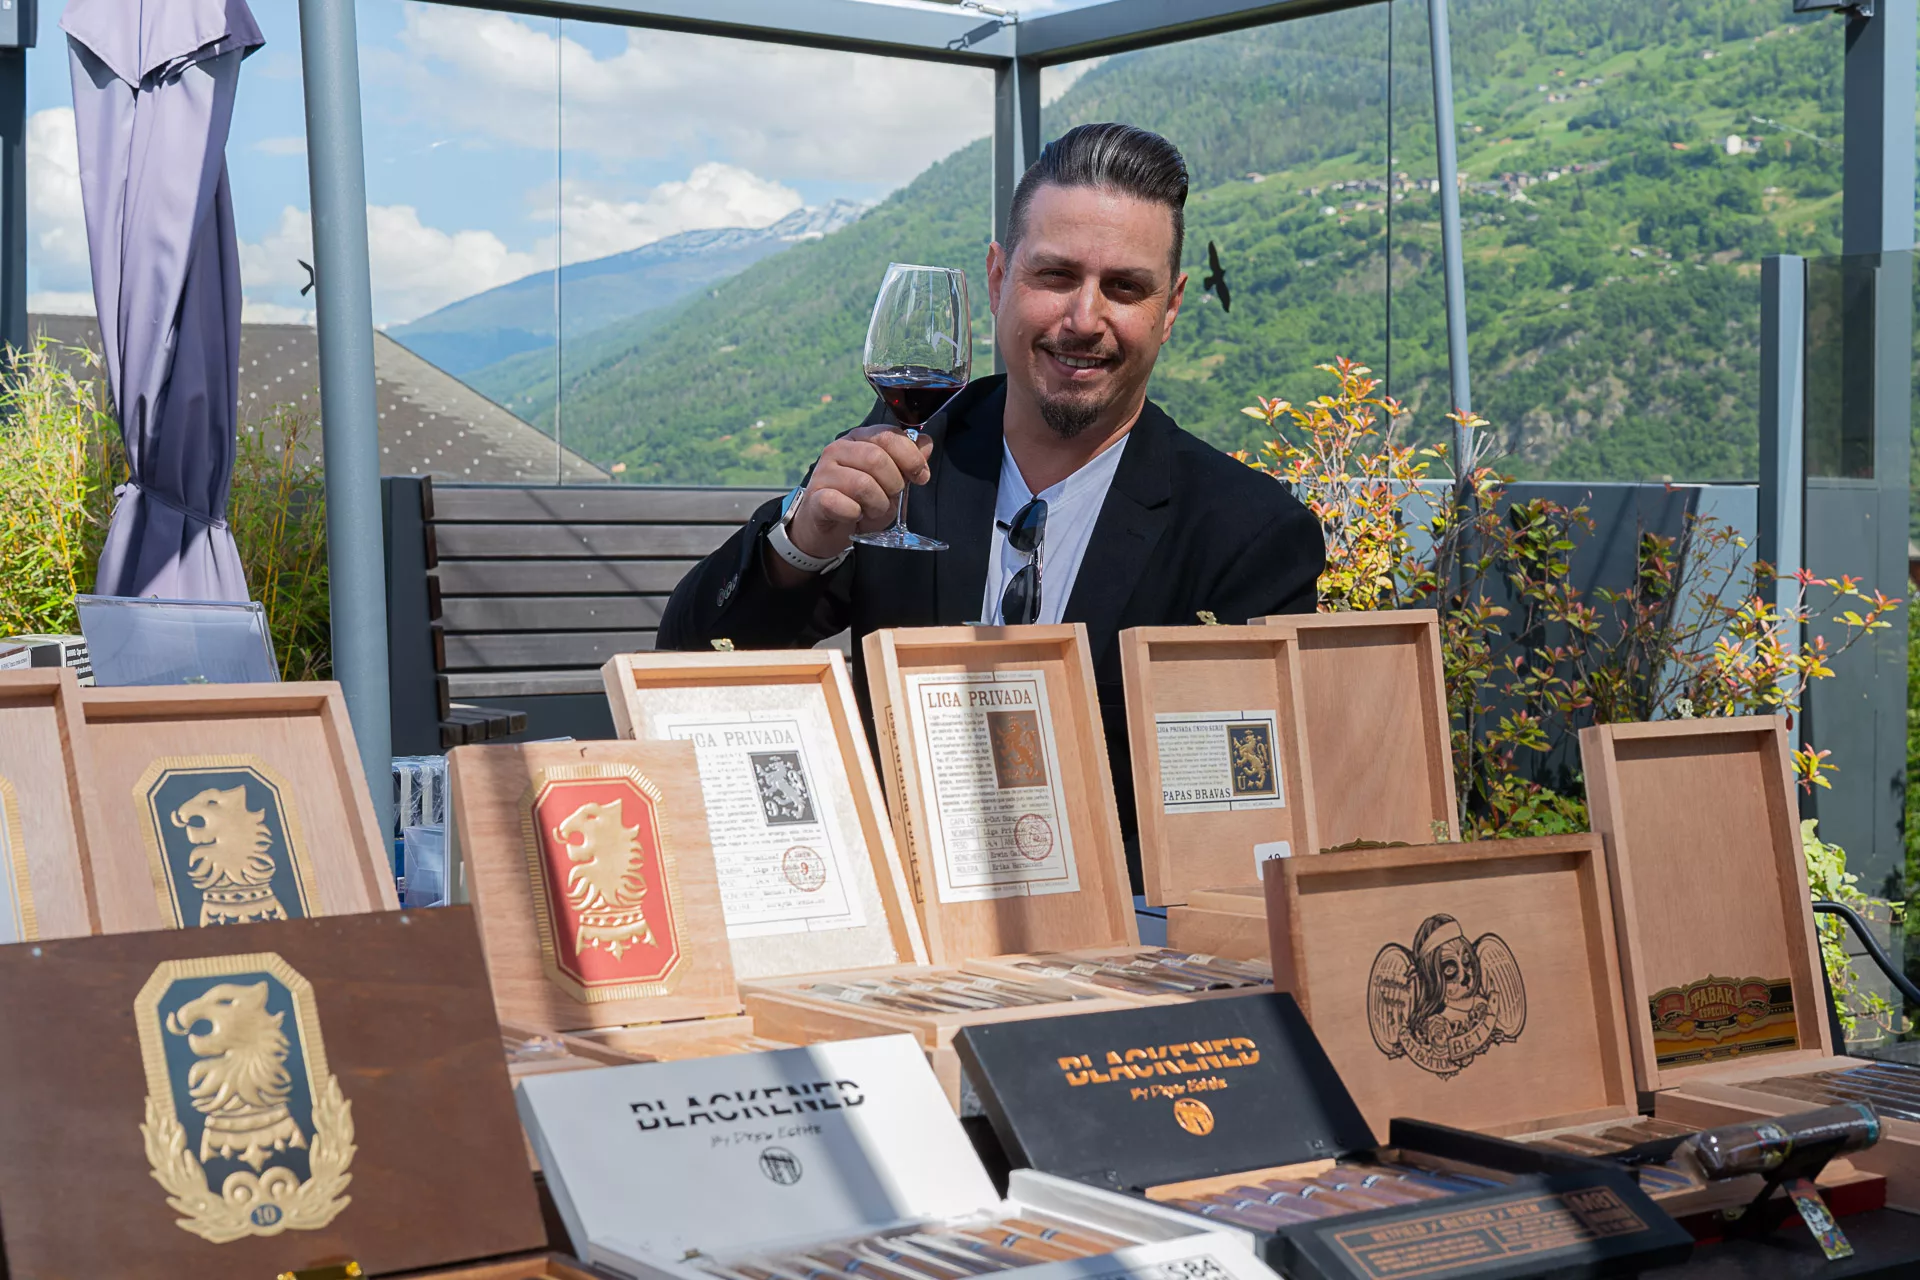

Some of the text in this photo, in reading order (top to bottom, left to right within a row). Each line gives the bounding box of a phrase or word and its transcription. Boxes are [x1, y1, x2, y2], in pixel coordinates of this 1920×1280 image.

[927, 688, 1033, 708] LIGA PRIVADA
[723, 729, 795, 746] PRIVADA
[1169, 725, 1191, 734] PRIVADA
[1163, 787, 1231, 801] PAPAS BRAVAS
[765, 800, 780, 818] 9
[1691, 987, 1735, 1008] TABAK
[1698, 1005, 1731, 1019] ESPECIAL
[1057, 1036, 1261, 1087] BLACKENED
[629, 1079, 865, 1131] BLACKENED
[255, 1206, 277, 1225] 10
